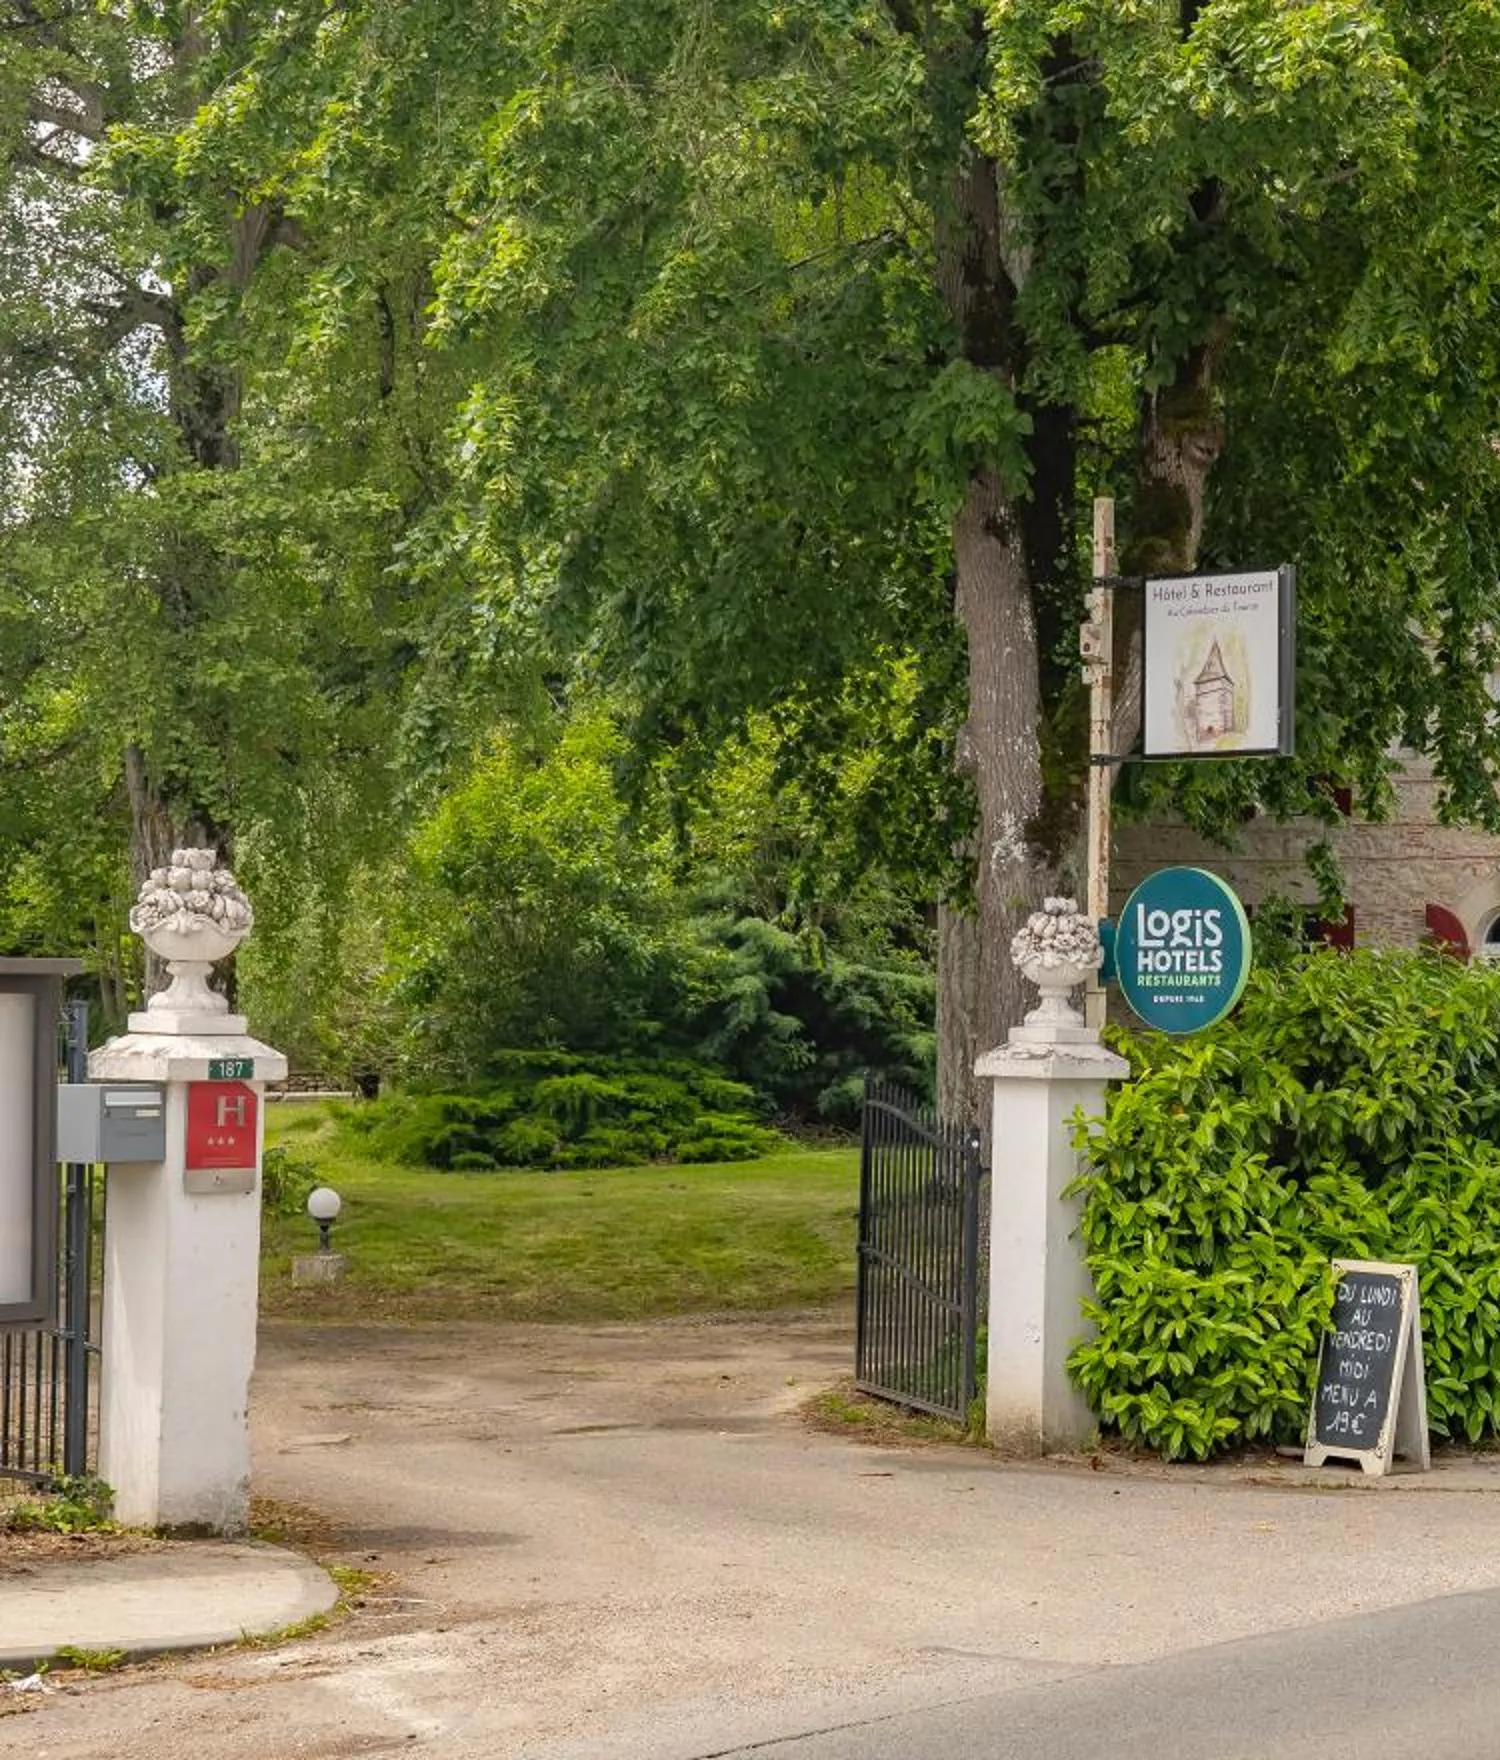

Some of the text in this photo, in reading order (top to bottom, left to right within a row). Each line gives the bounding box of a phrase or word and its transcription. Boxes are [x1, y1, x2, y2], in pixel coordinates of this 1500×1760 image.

[1153, 585, 1187, 600] Hôtel
[1205, 581, 1273, 597] Restaurant
[1137, 949, 1223, 973] HOTELS
[1137, 974, 1221, 987] RESTAURANTS
[219, 1061, 243, 1077] 187
[217, 1095, 245, 1128] H
[1338, 1283, 1356, 1301] DU
[1351, 1309, 1373, 1326] AU
[1321, 1383, 1378, 1409] MENU A
